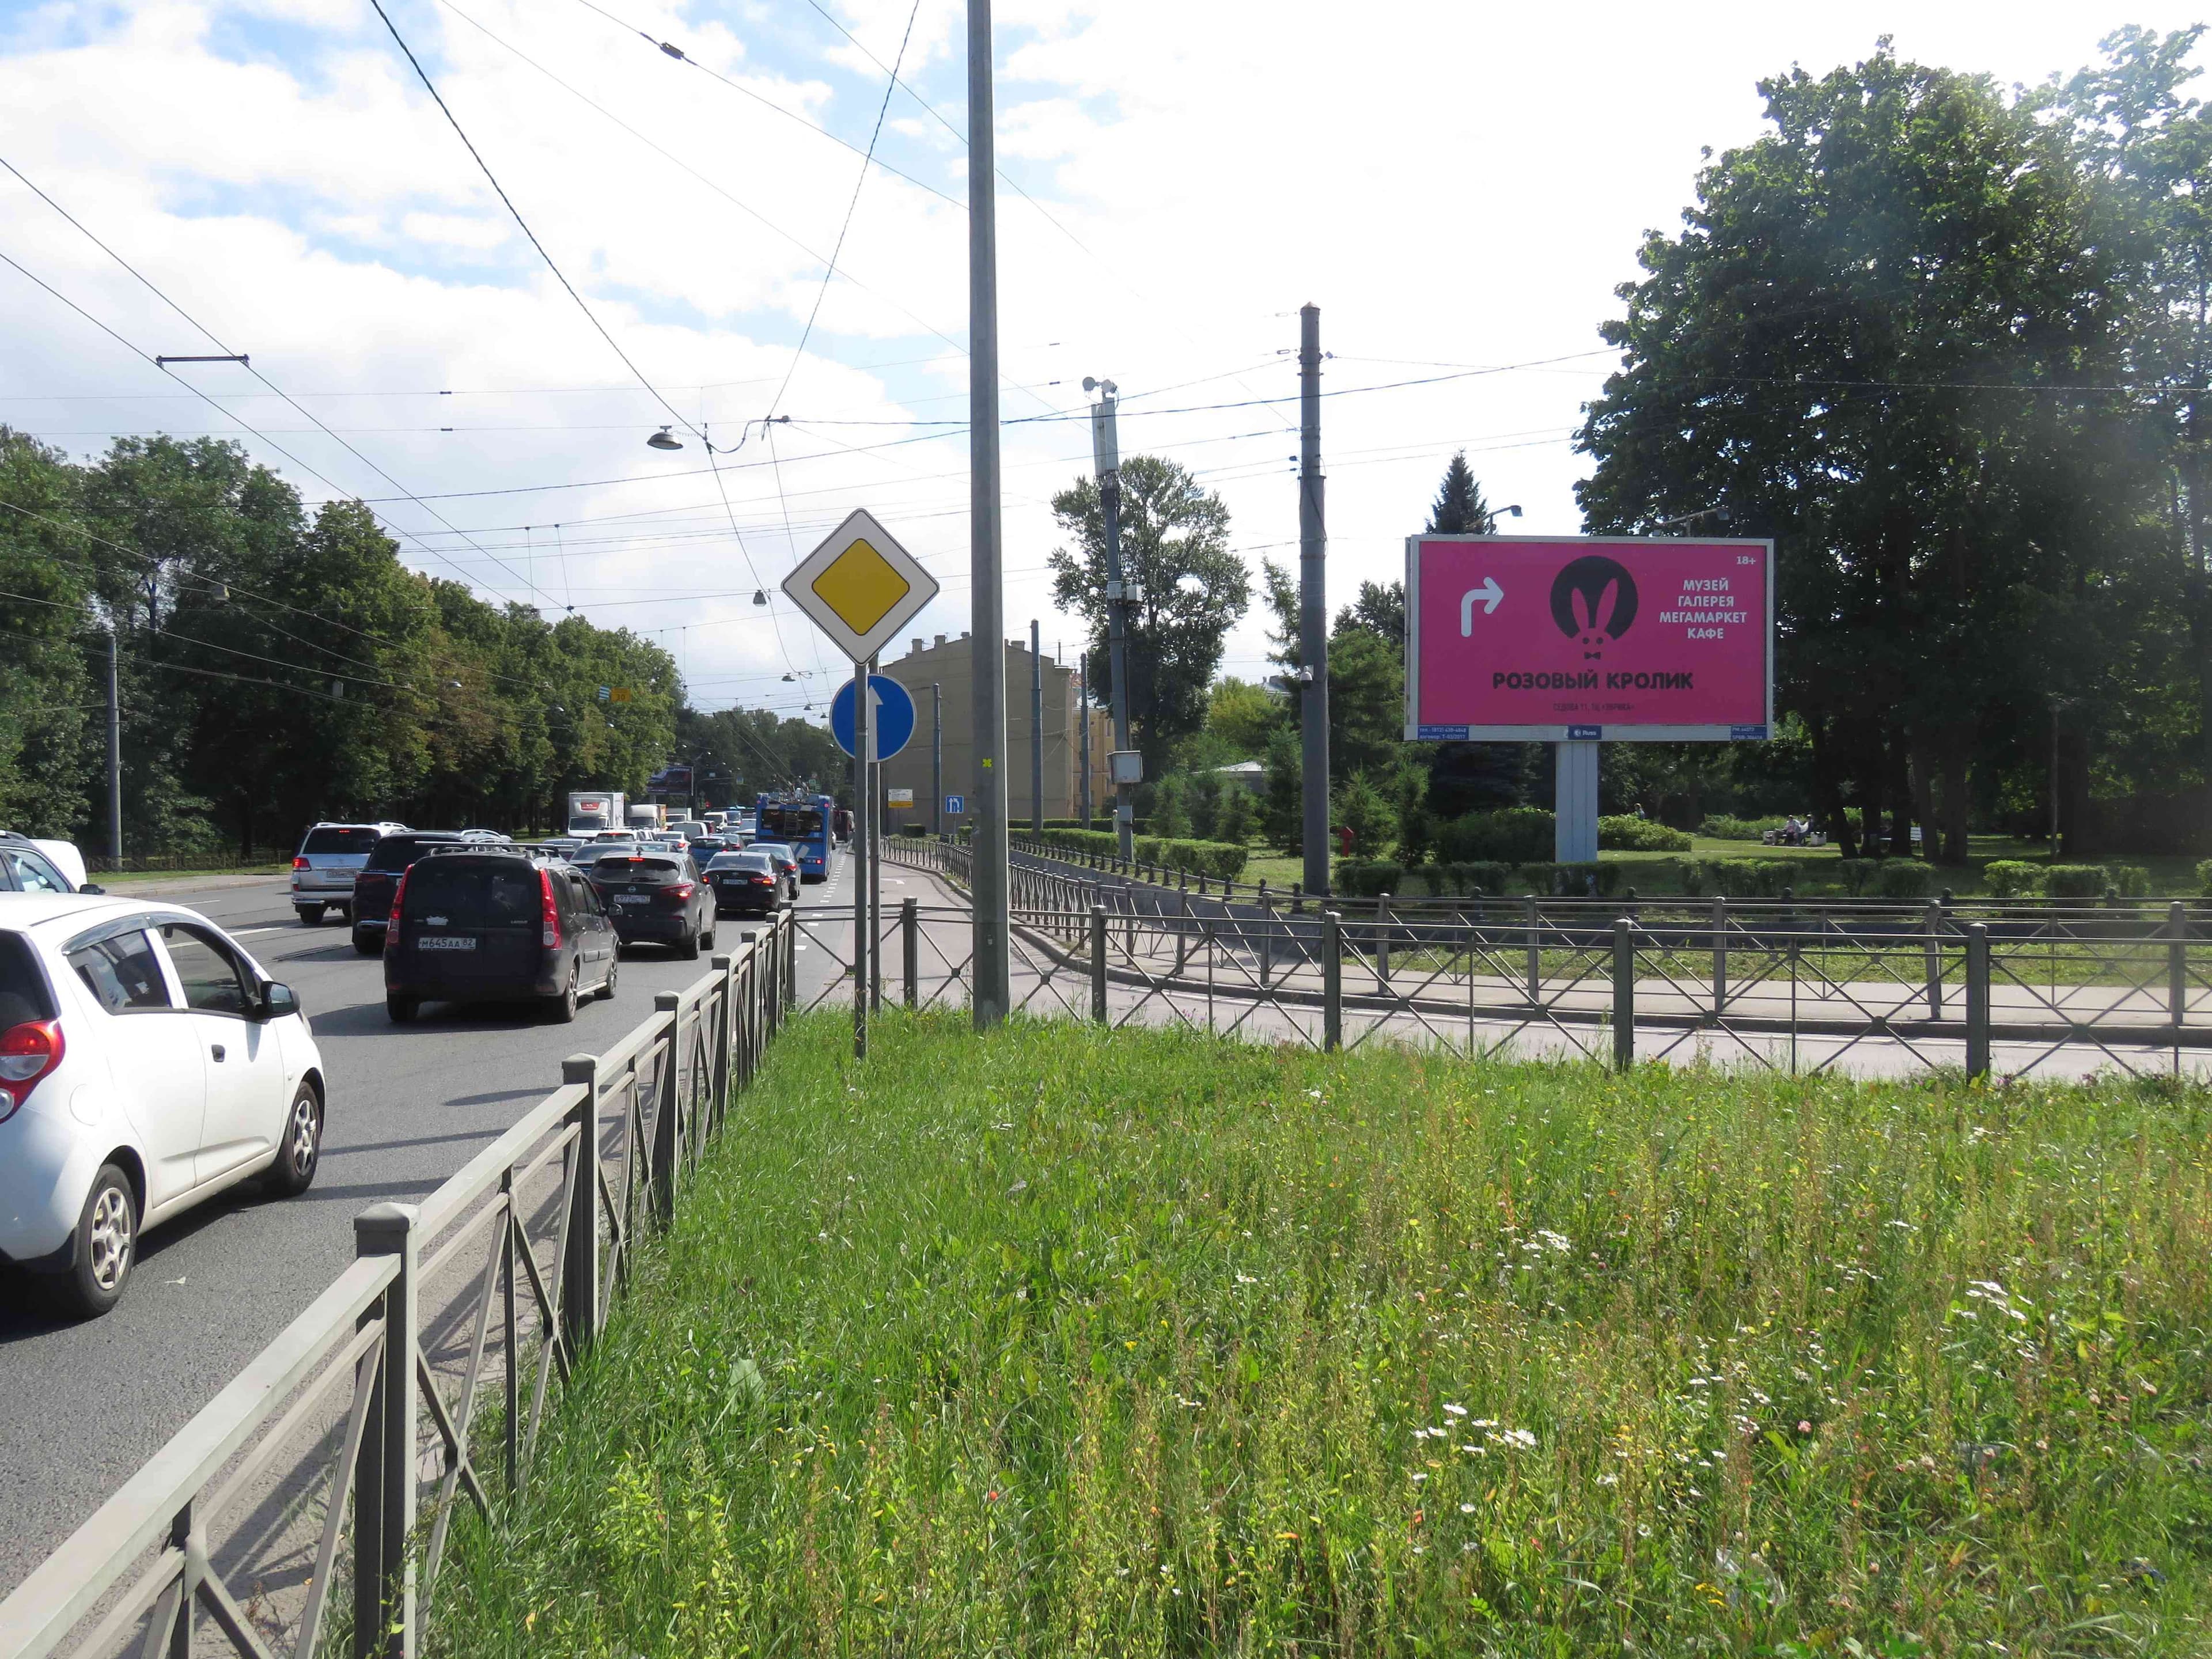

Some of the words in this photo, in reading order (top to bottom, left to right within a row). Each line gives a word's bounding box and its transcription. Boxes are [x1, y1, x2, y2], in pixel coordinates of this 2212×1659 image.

[1737, 555, 1756, 565] 18+
[1683, 577, 1729, 592] МУЗЕЙ
[1678, 596, 1734, 607] ГАЛЕРЕЯ
[1659, 611, 1747, 623] МЕГАМАРКЕТ
[1687, 628, 1724, 639] КАФЕ
[1493, 669, 1599, 690] РОЗОВЫЙ
[1607, 672, 1694, 690] КРОЛИК
